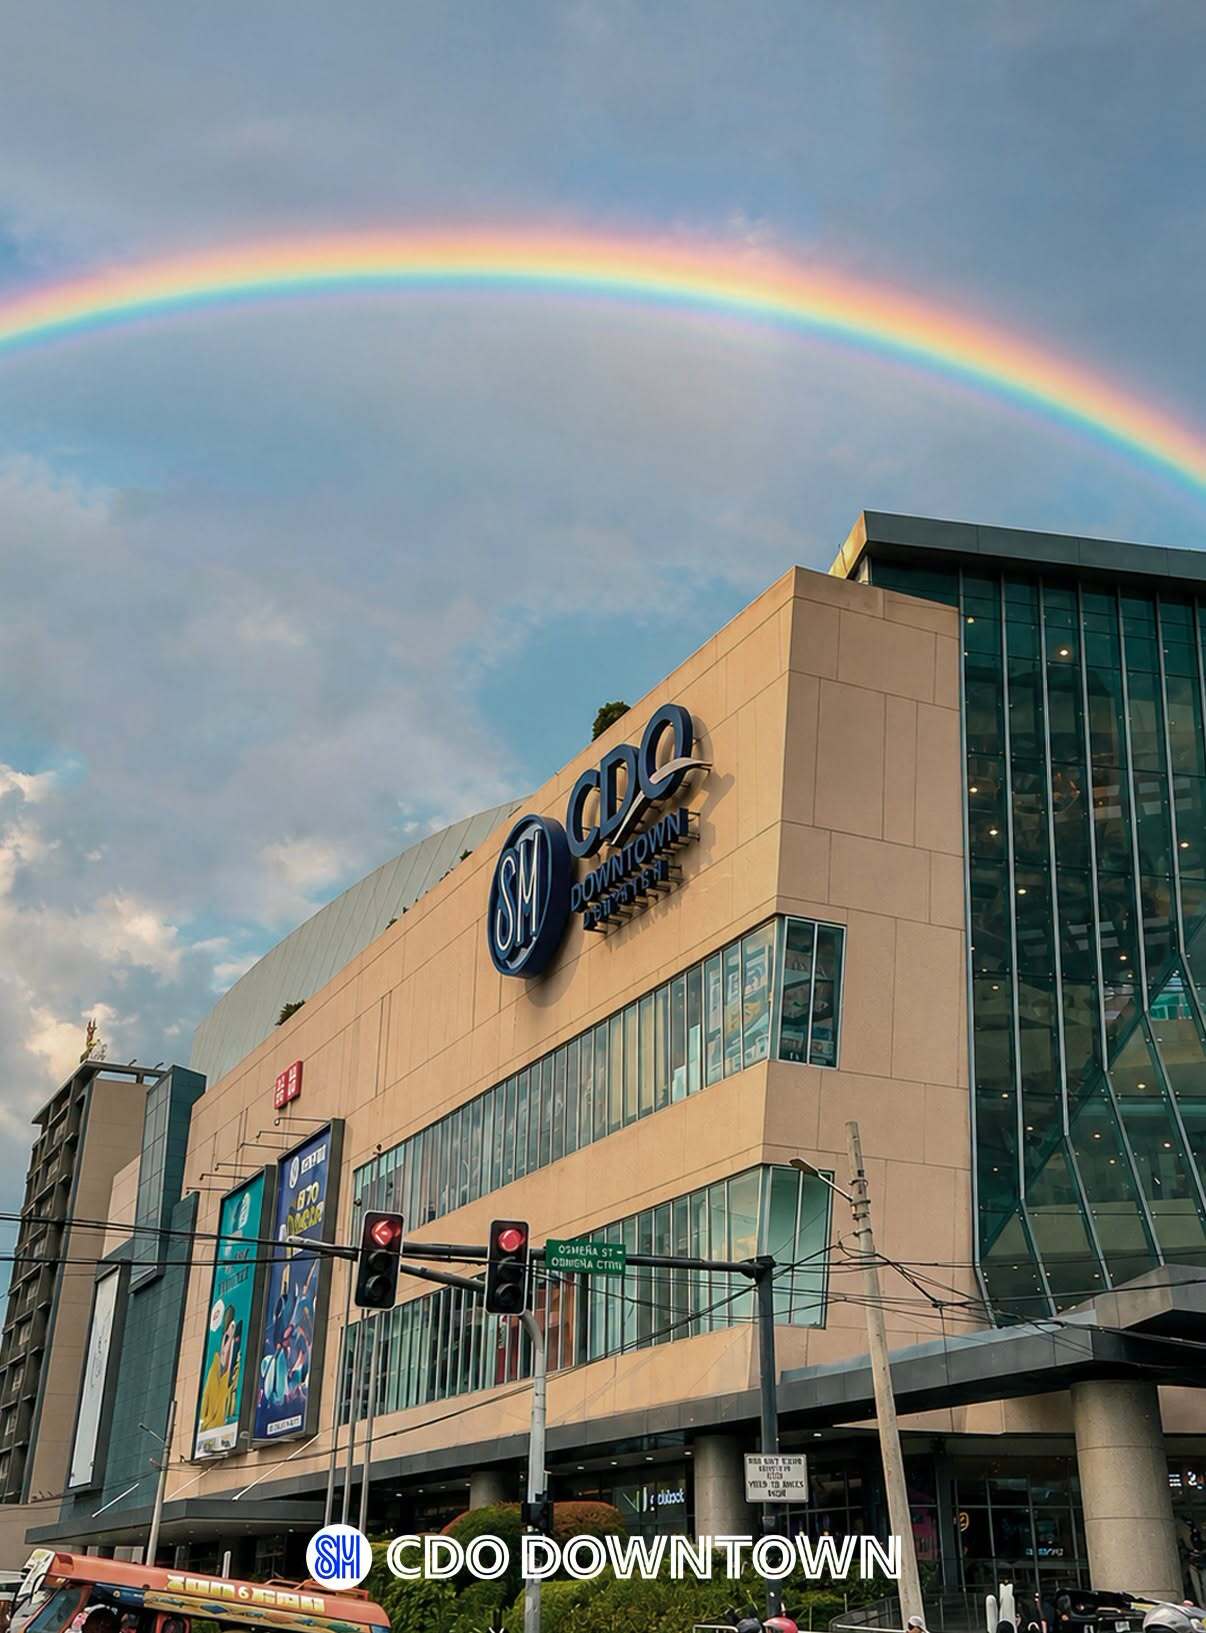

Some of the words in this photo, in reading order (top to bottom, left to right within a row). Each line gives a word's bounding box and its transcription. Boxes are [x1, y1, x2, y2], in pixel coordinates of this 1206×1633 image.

[566, 703, 694, 858] CDO
[496, 827, 545, 960] SM
[570, 807, 689, 913] DOWNTOWN
